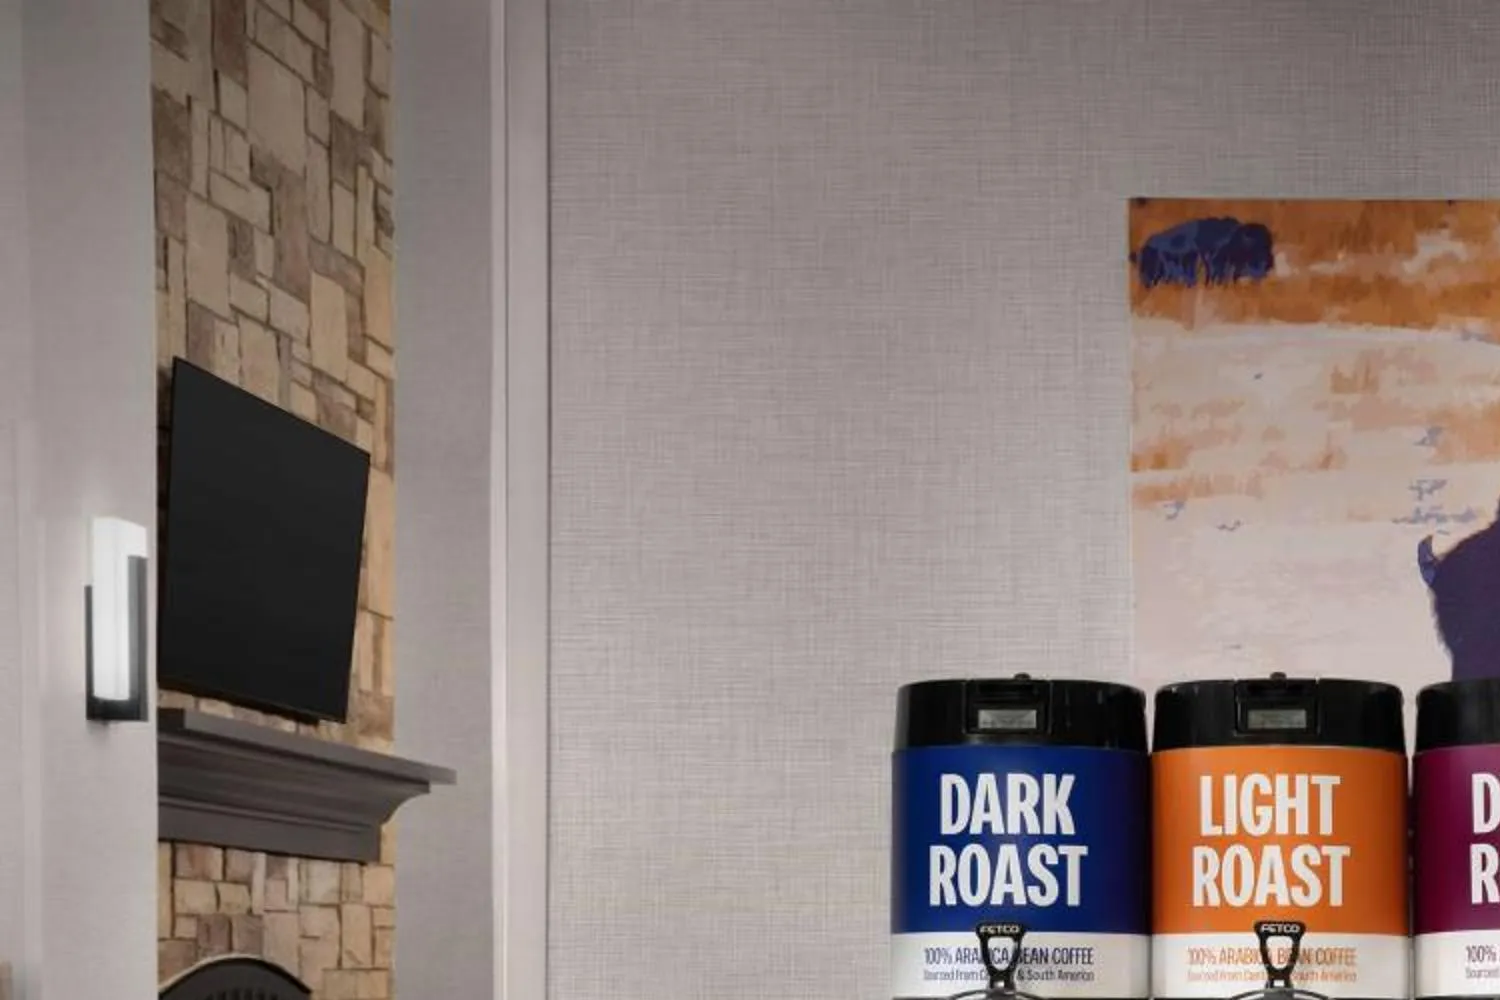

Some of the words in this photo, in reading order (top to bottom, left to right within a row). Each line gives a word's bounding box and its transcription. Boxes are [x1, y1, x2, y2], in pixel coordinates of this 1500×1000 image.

[940, 773, 1076, 835] DARK
[1199, 773, 1342, 837] LIGHT
[928, 843, 1089, 908] ROAST
[1192, 844, 1351, 908] ROAST
[979, 924, 1020, 934] FETCO
[1260, 923, 1301, 933] FETCO
[924, 947, 953, 965] 100%
[1052, 947, 1094, 965] COFFEE
[1315, 947, 1358, 965] COFFEE
[1465, 944, 1497, 963] 100%
